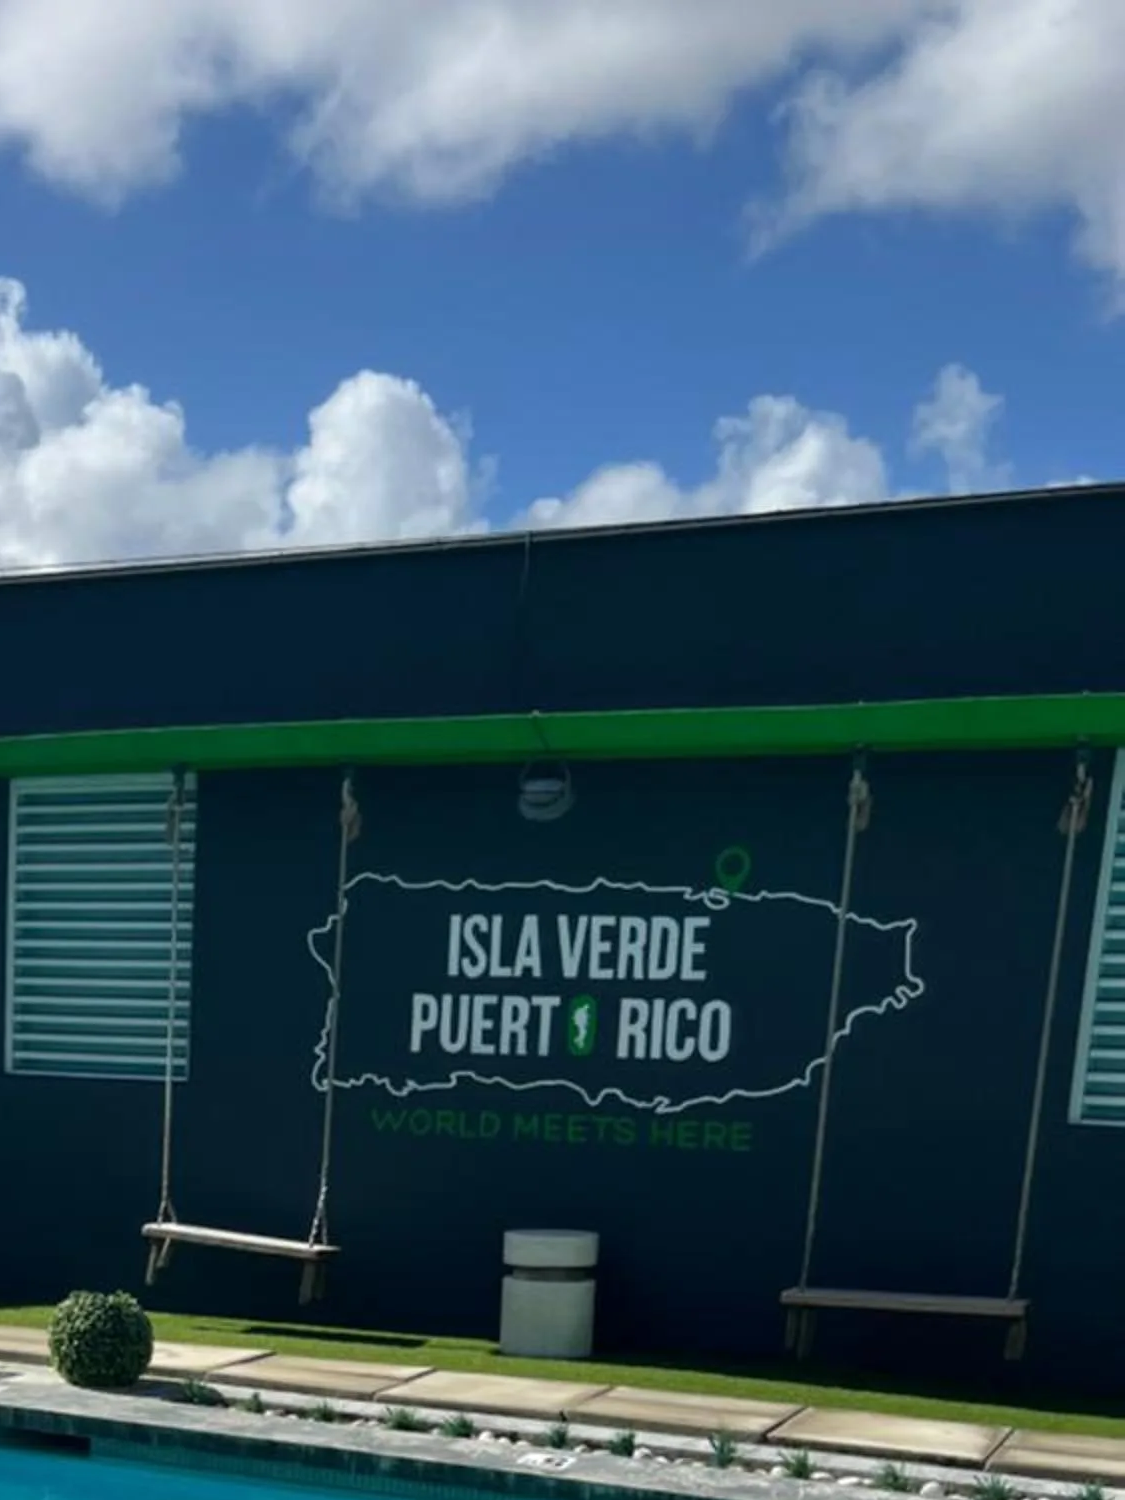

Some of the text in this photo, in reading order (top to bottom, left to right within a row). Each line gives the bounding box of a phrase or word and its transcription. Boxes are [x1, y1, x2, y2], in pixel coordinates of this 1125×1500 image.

[448, 914, 711, 981] ISLA VERDE
[616, 999, 732, 1062] RICO
[370, 1107, 755, 1152] WORLD MEETS HERE
